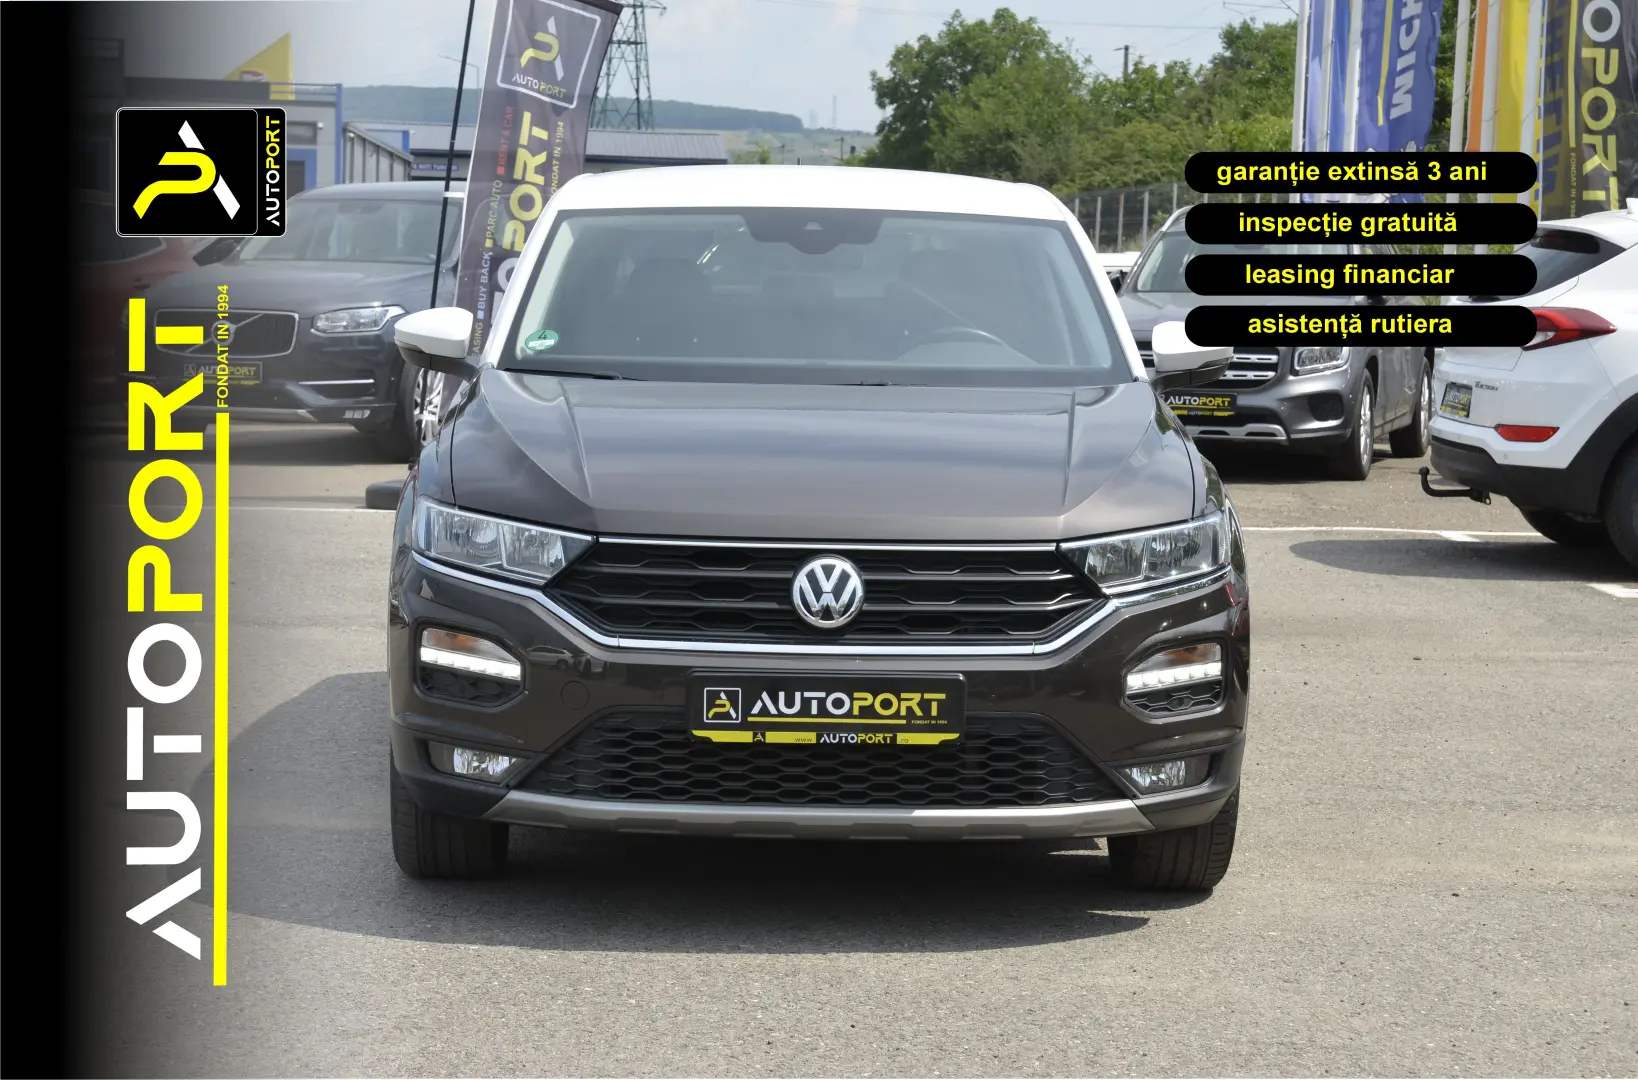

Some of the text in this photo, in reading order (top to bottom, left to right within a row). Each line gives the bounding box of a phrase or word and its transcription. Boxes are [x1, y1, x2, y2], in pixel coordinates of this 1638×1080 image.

[553, 147, 560, 157] IN
[551, 160, 559, 194] ONDAT
[490, 180, 503, 208] AUTO
[485, 210, 497, 239] PARC
[481, 252, 493, 283] BACK
[478, 288, 487, 309] BUY
[472, 322, 483, 357] EASING
[538, 330, 548, 340] 4
[1166, 396, 1231, 407] AUTOPORT
[750, 691, 946, 715] AUTOPORT
[819, 733, 894, 744] AUTOPORT
